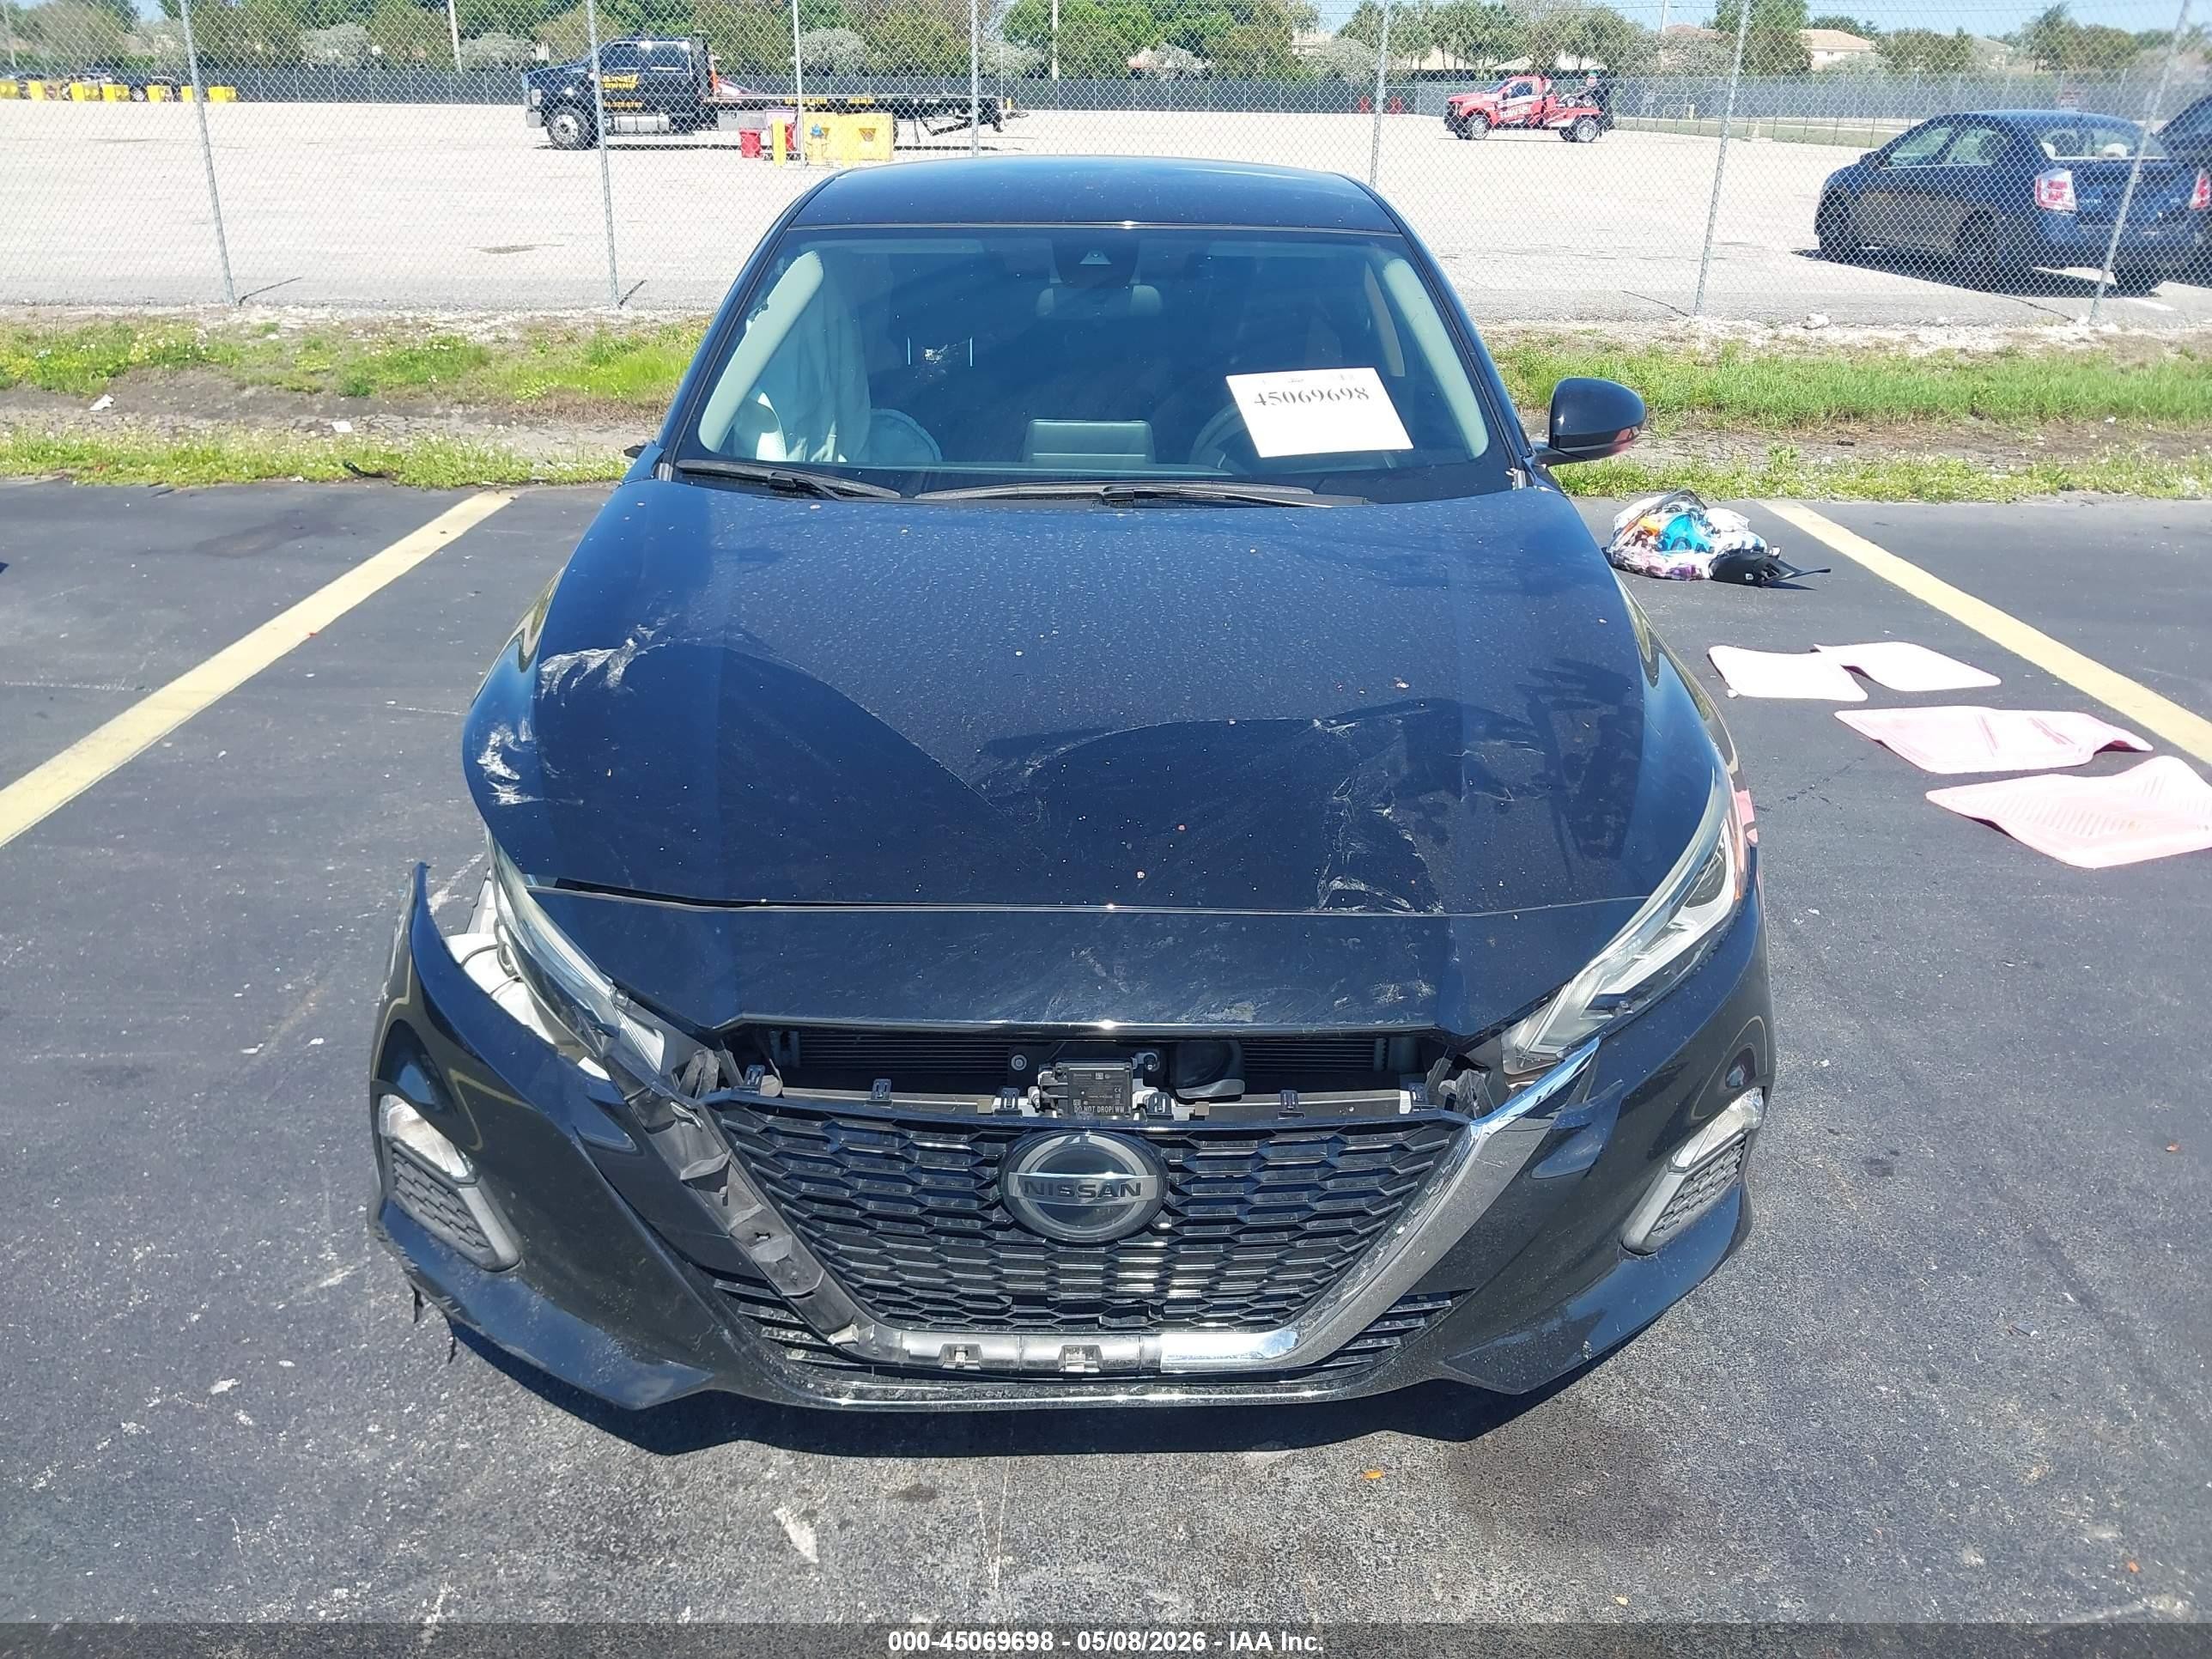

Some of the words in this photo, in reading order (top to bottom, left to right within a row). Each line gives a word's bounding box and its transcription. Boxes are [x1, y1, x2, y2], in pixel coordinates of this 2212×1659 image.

[1254, 386, 1370, 406] 45069698
[1084, 1105, 1096, 1114] NOT
[1024, 1180, 1141, 1199] NISSAN
